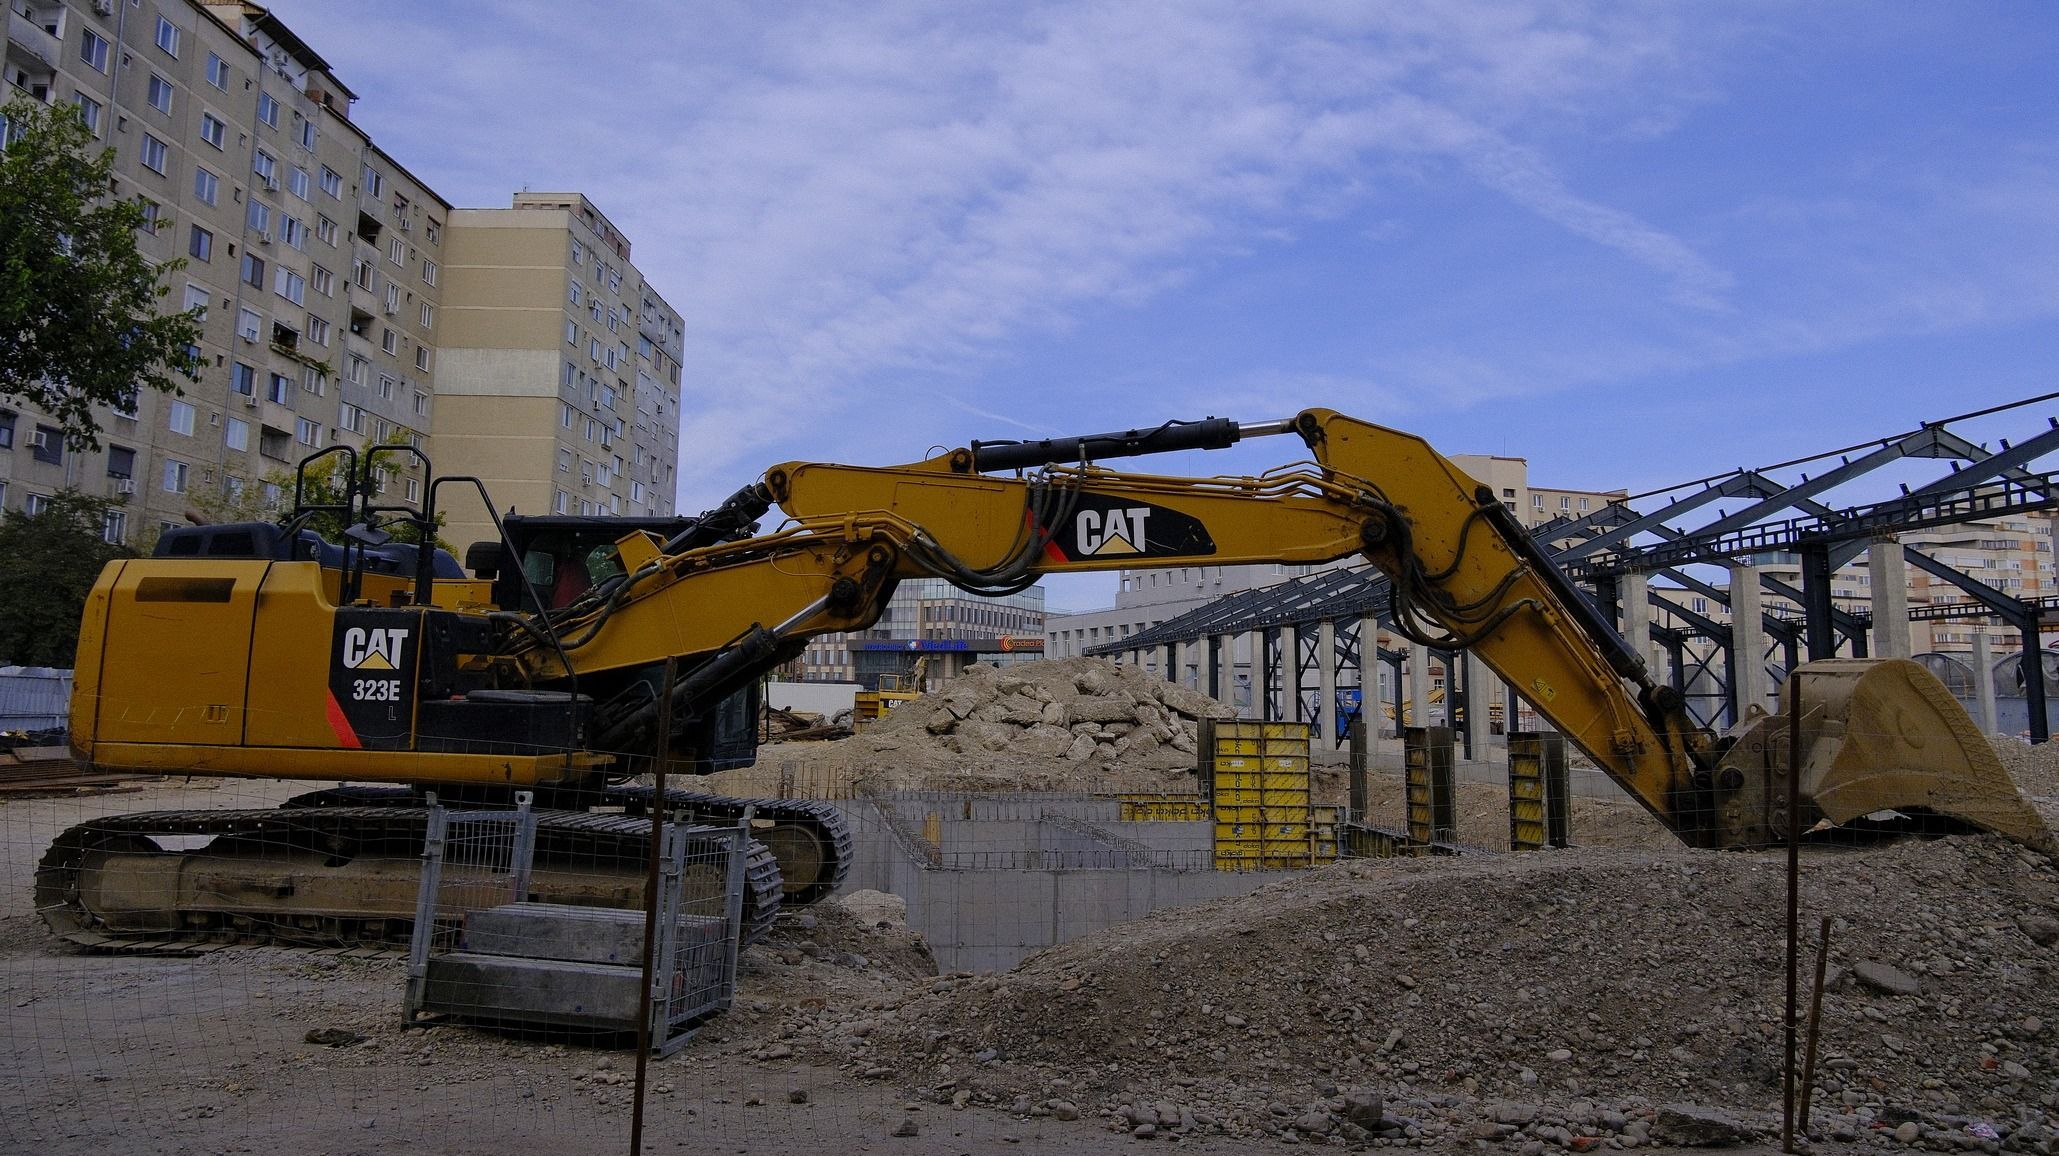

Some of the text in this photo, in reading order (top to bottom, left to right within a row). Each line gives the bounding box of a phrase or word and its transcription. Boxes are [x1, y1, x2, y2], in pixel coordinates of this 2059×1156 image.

[1076, 507, 1151, 556] CAT
[343, 627, 409, 669] CAT
[352, 679, 401, 701] 323E
[388, 705, 397, 721] L
[888, 700, 903, 708] CAT
